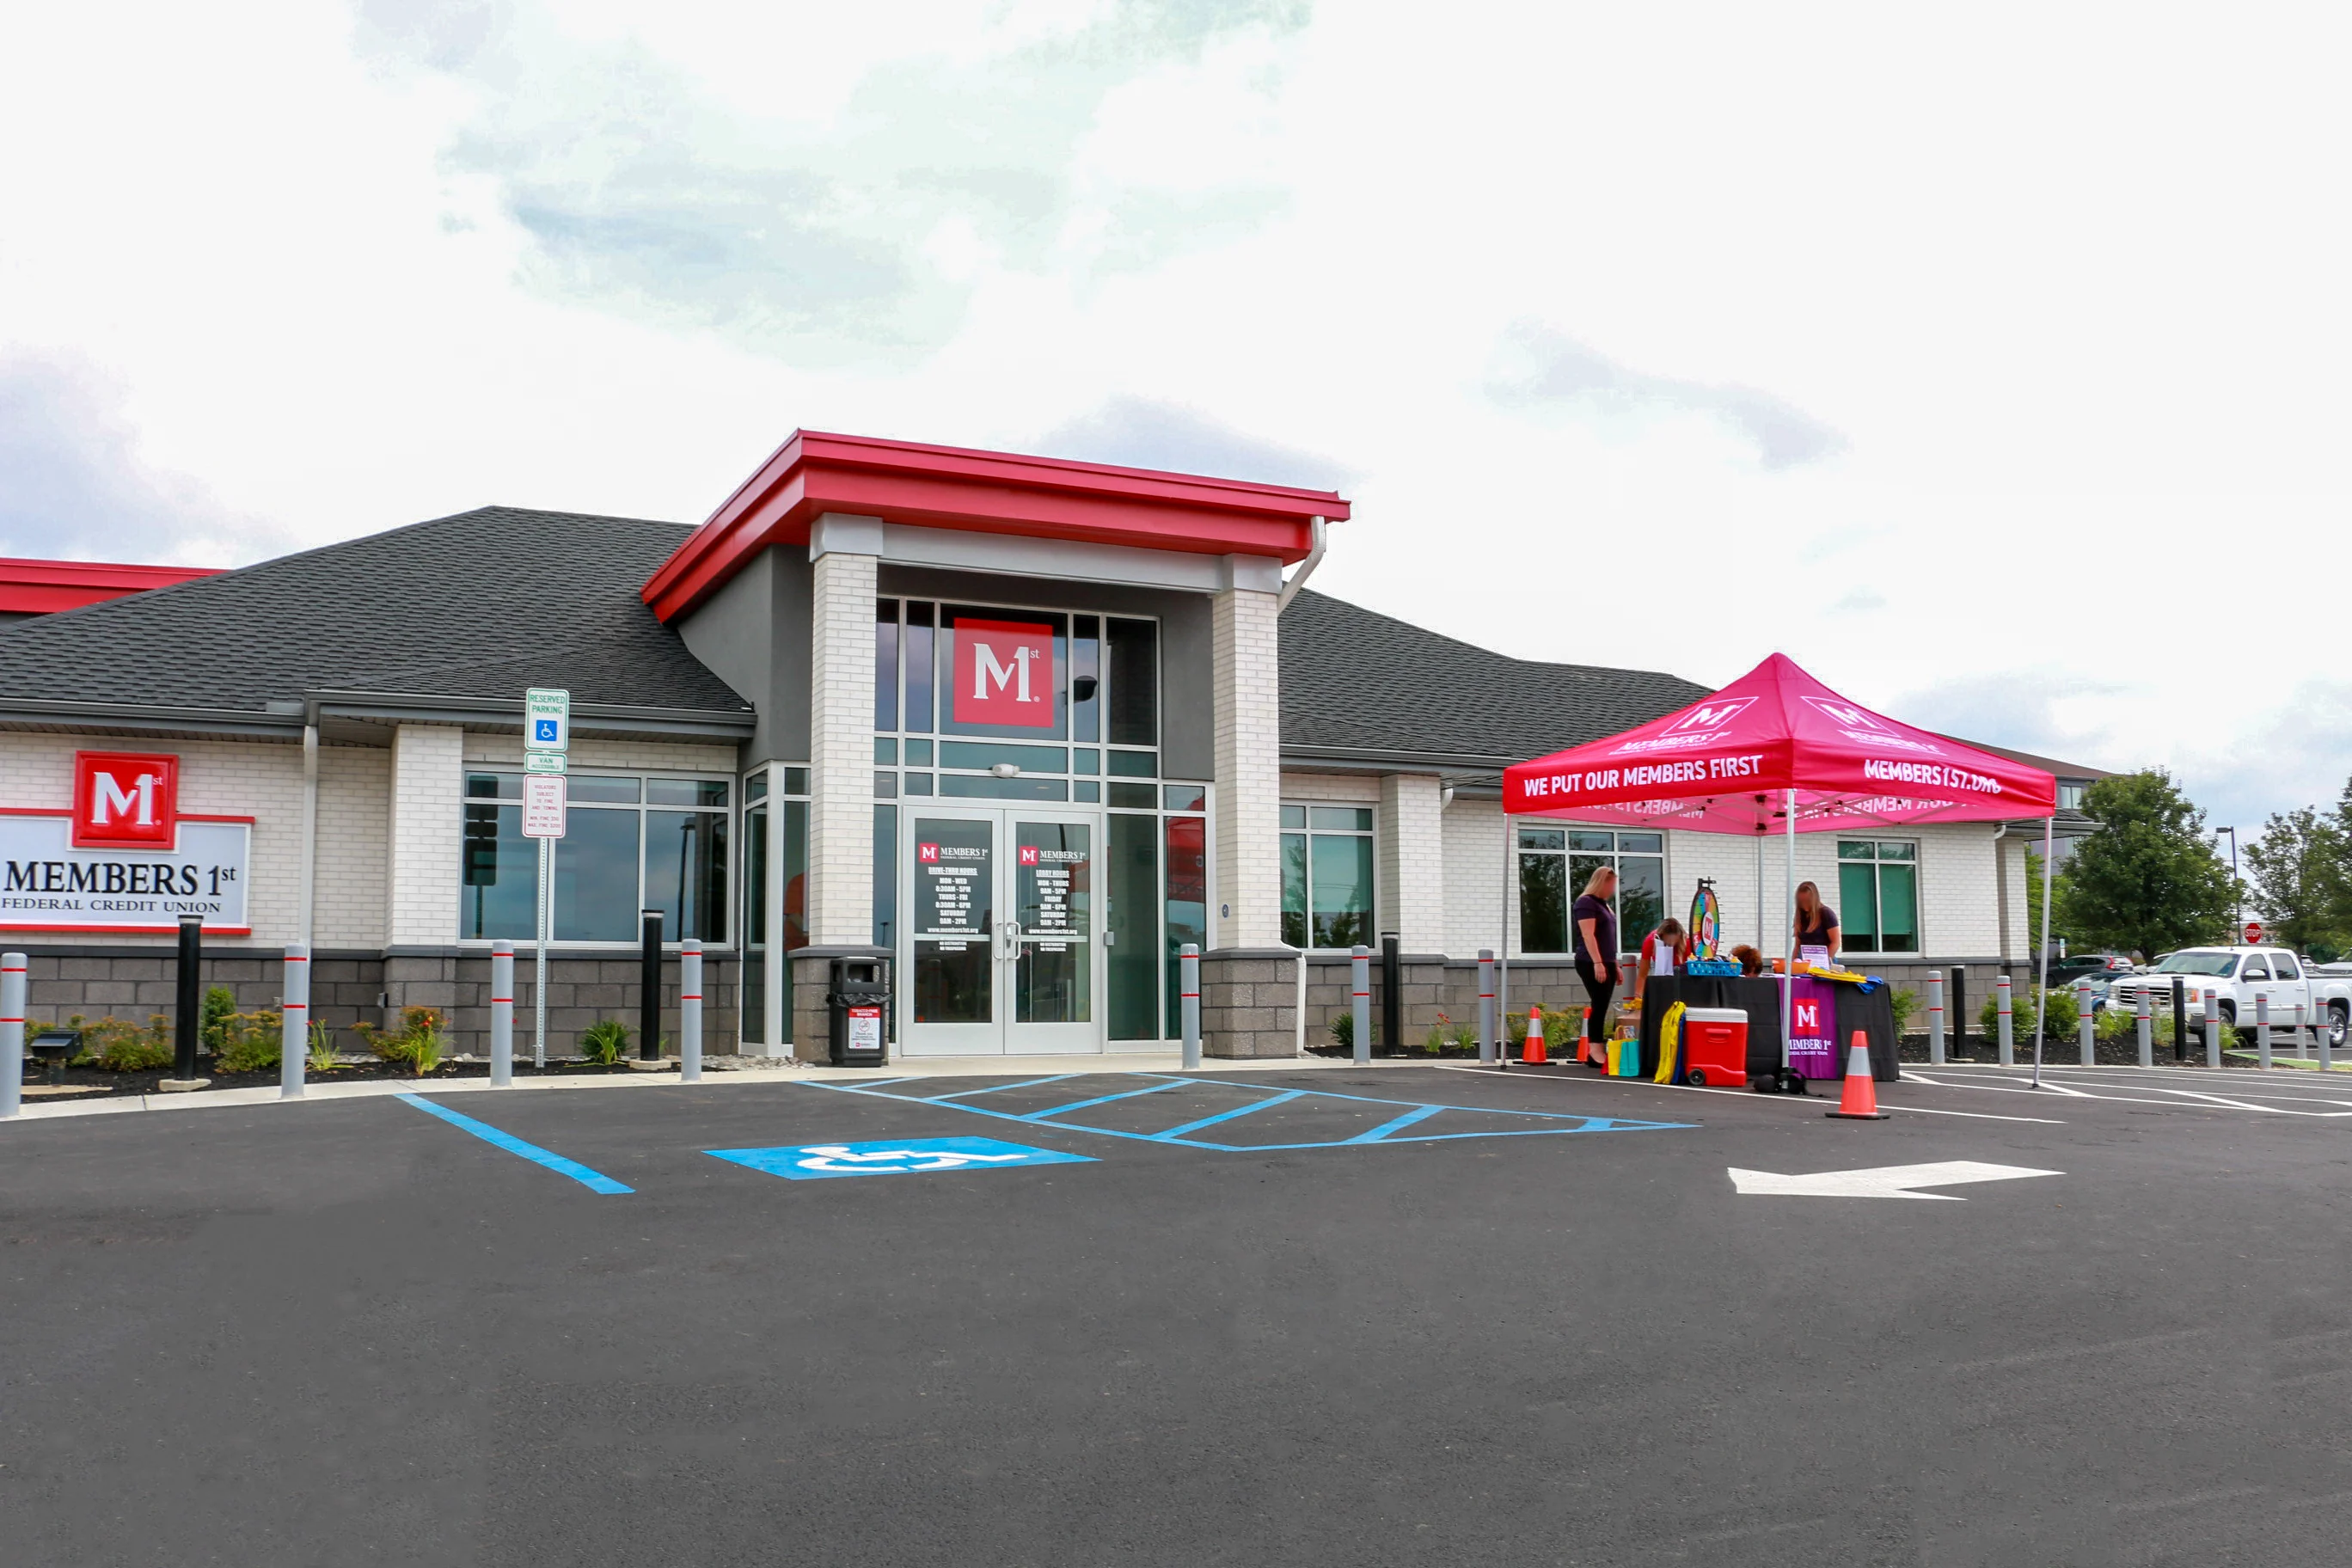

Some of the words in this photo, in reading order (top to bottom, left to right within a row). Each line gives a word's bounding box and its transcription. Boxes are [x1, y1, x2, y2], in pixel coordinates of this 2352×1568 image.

[530, 695, 565, 704] RESERVED
[532, 705, 563, 714] PARKING
[1616, 733, 1711, 752] MEMBERS
[1524, 778, 1548, 797] WE
[1551, 774, 1582, 794] PUT
[1585, 769, 1619, 790] OUR
[1623, 760, 1706, 787] MEMBERS
[1710, 755, 1763, 778] FIRST
[940, 848, 980, 856] MEMBERS
[1040, 850, 1078, 859] MEMBERS
[3, 861, 198, 895] MEMBERS
[2, 897, 83, 911] FEDERAL
[90, 900, 157, 912] CREDIT
[163, 901, 221, 913] UNION
